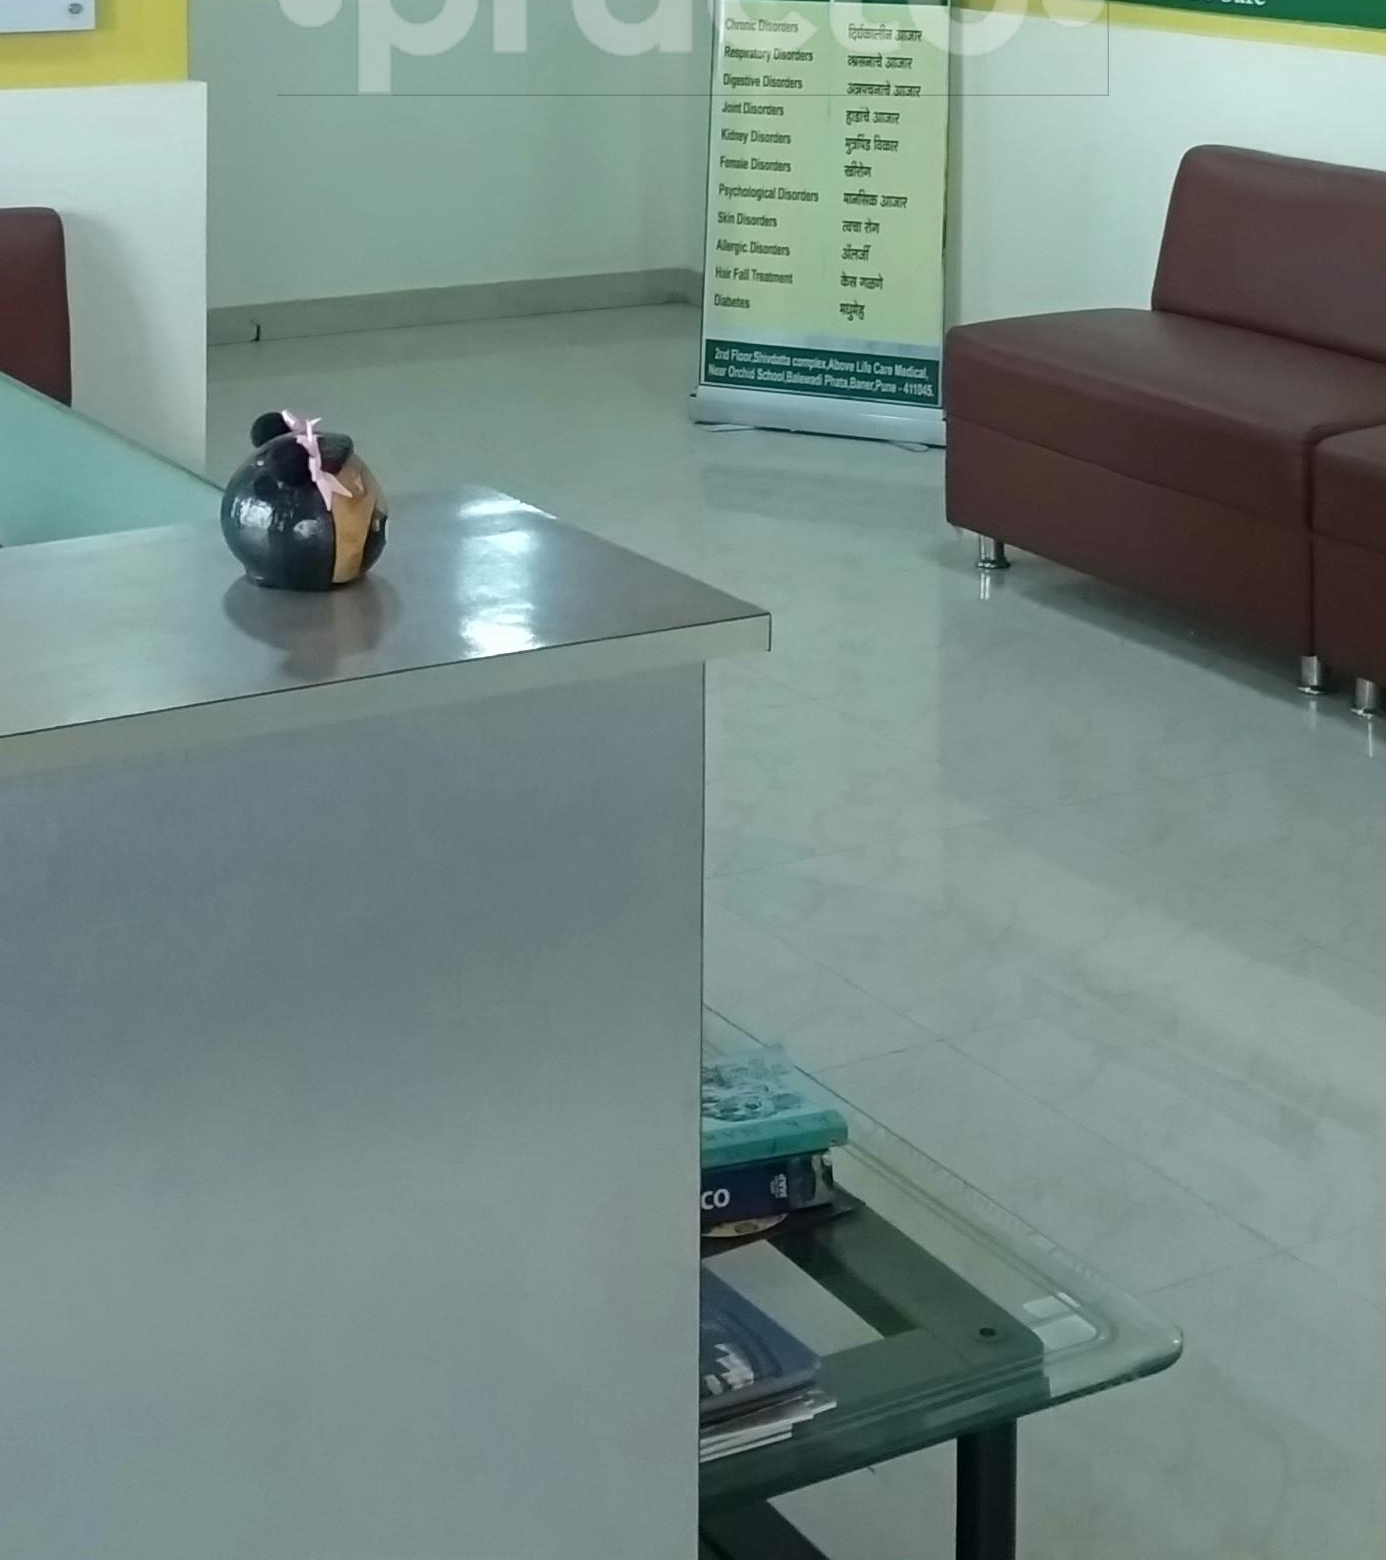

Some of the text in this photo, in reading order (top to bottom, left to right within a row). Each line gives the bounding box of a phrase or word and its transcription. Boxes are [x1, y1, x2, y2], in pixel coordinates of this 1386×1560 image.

[723, 73, 803, 89] Digestive Disorders
[719, 183, 819, 202] Psychological Disorders
